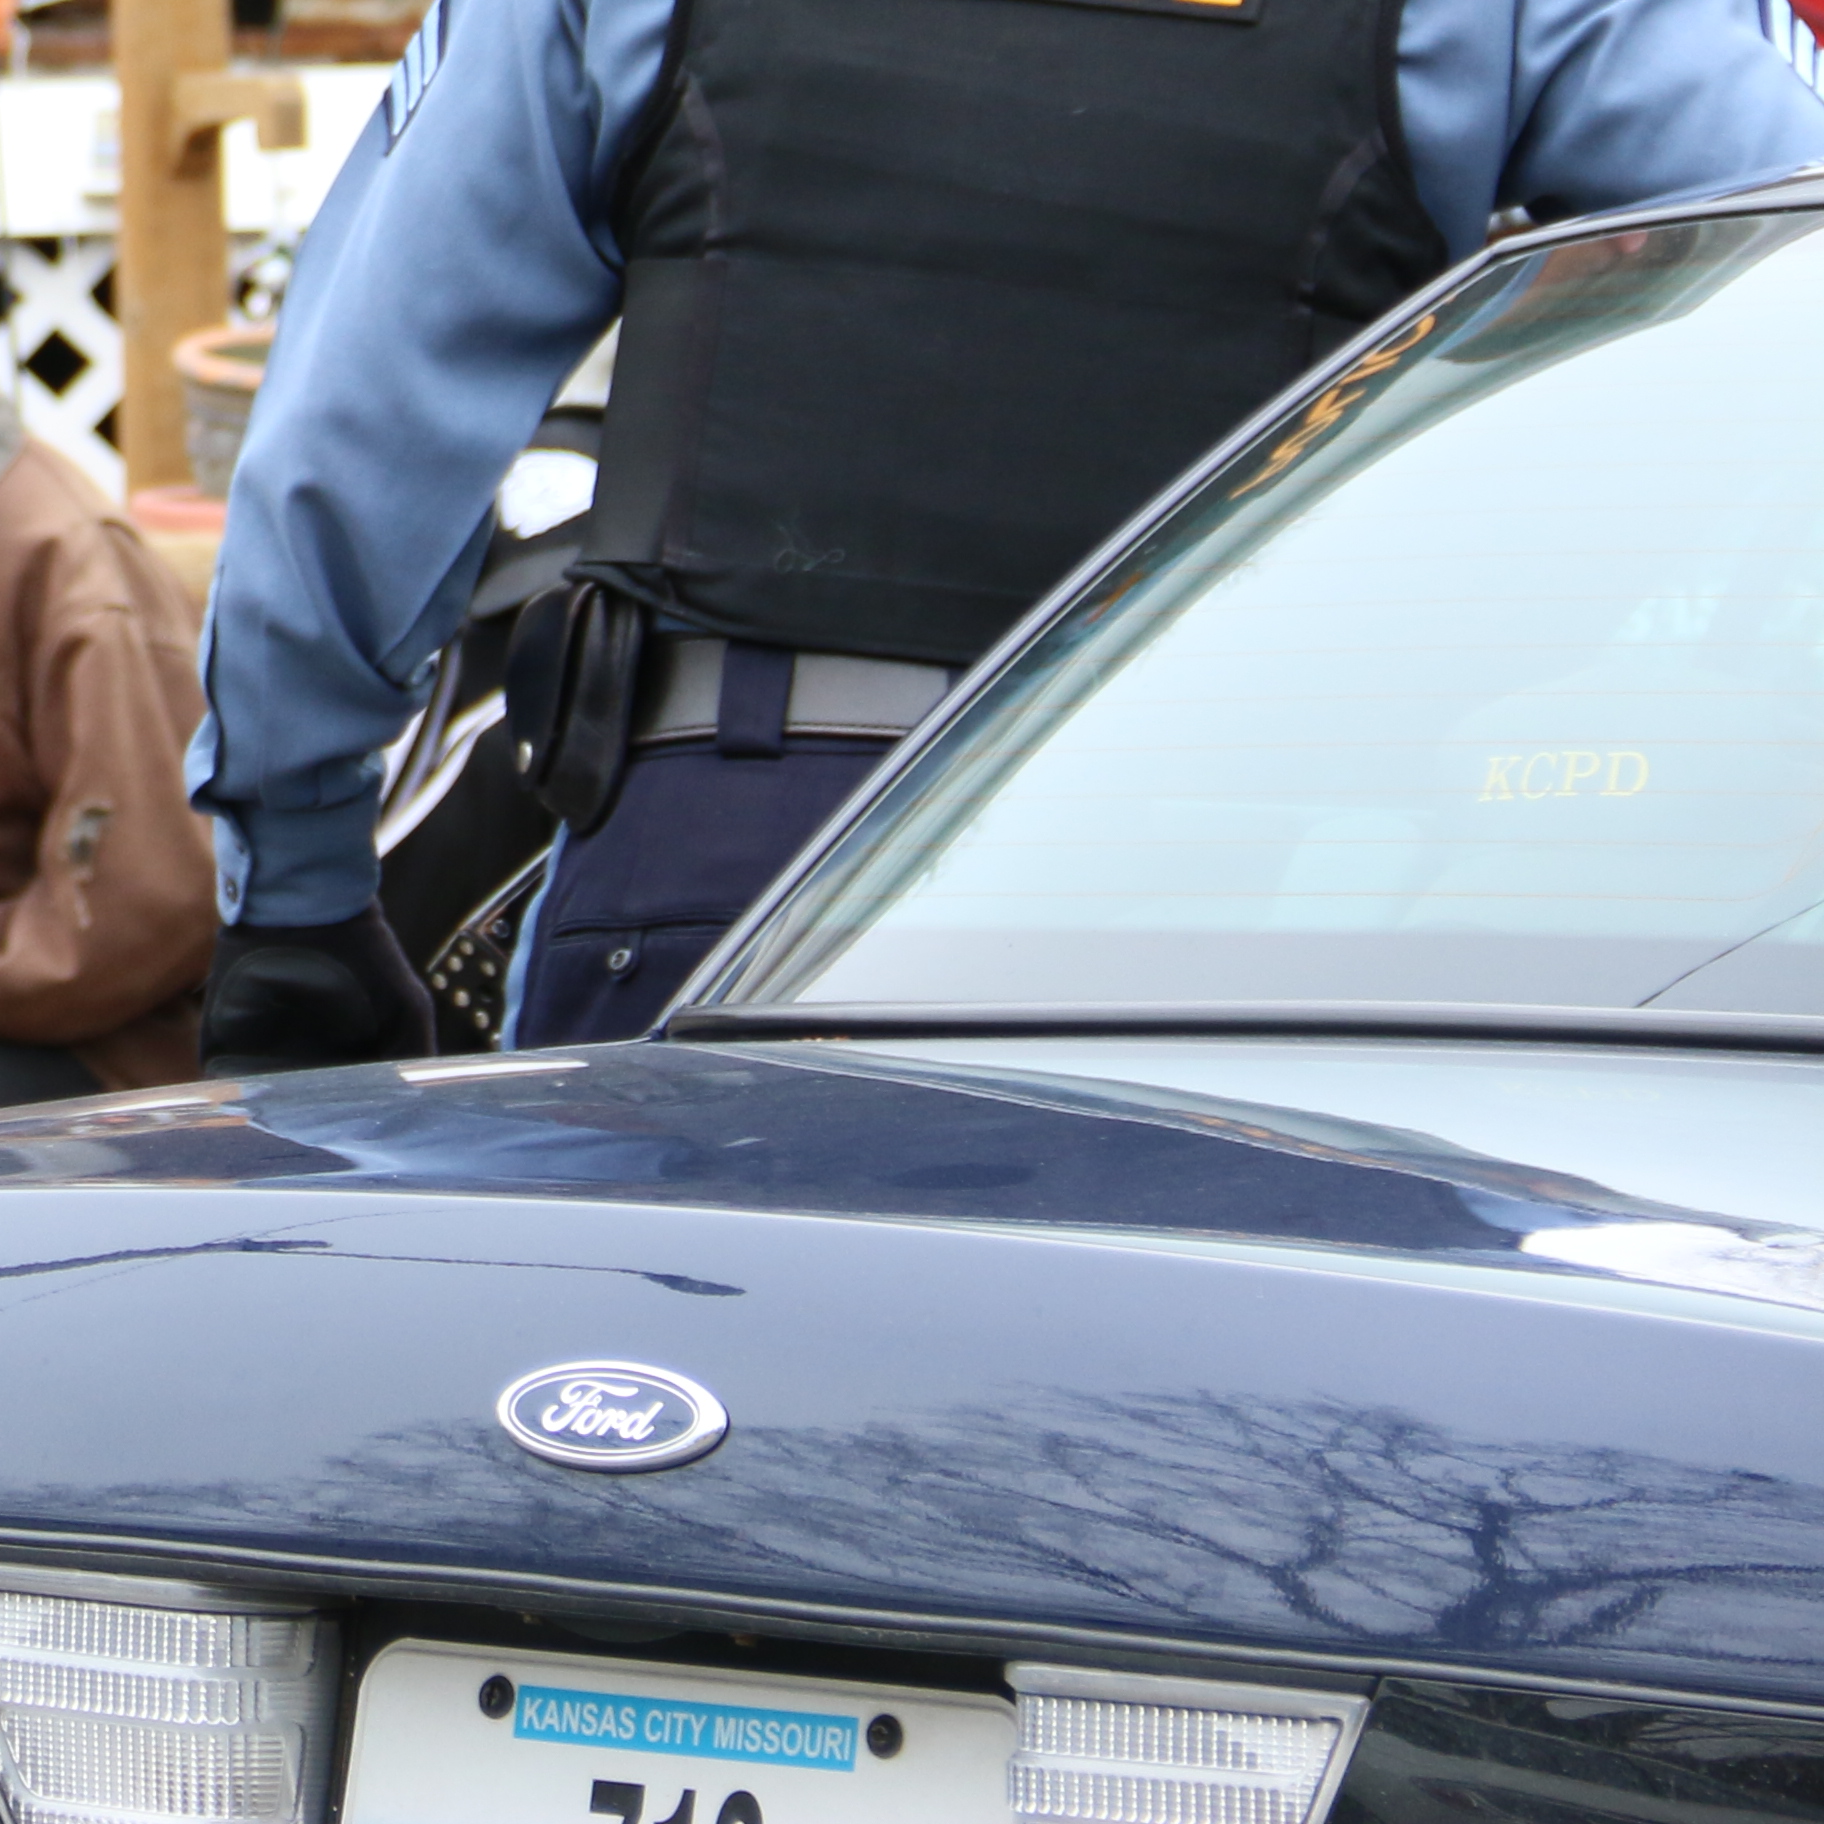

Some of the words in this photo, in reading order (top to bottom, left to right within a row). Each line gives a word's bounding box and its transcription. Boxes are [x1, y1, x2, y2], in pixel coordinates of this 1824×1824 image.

[1477, 750, 1650, 802] KCPD
[541, 1379, 664, 1440] Ford
[522, 1697, 637, 1740] KANSAS
[644, 1709, 707, 1746] CITY
[713, 1715, 852, 1761] MISSOURI
